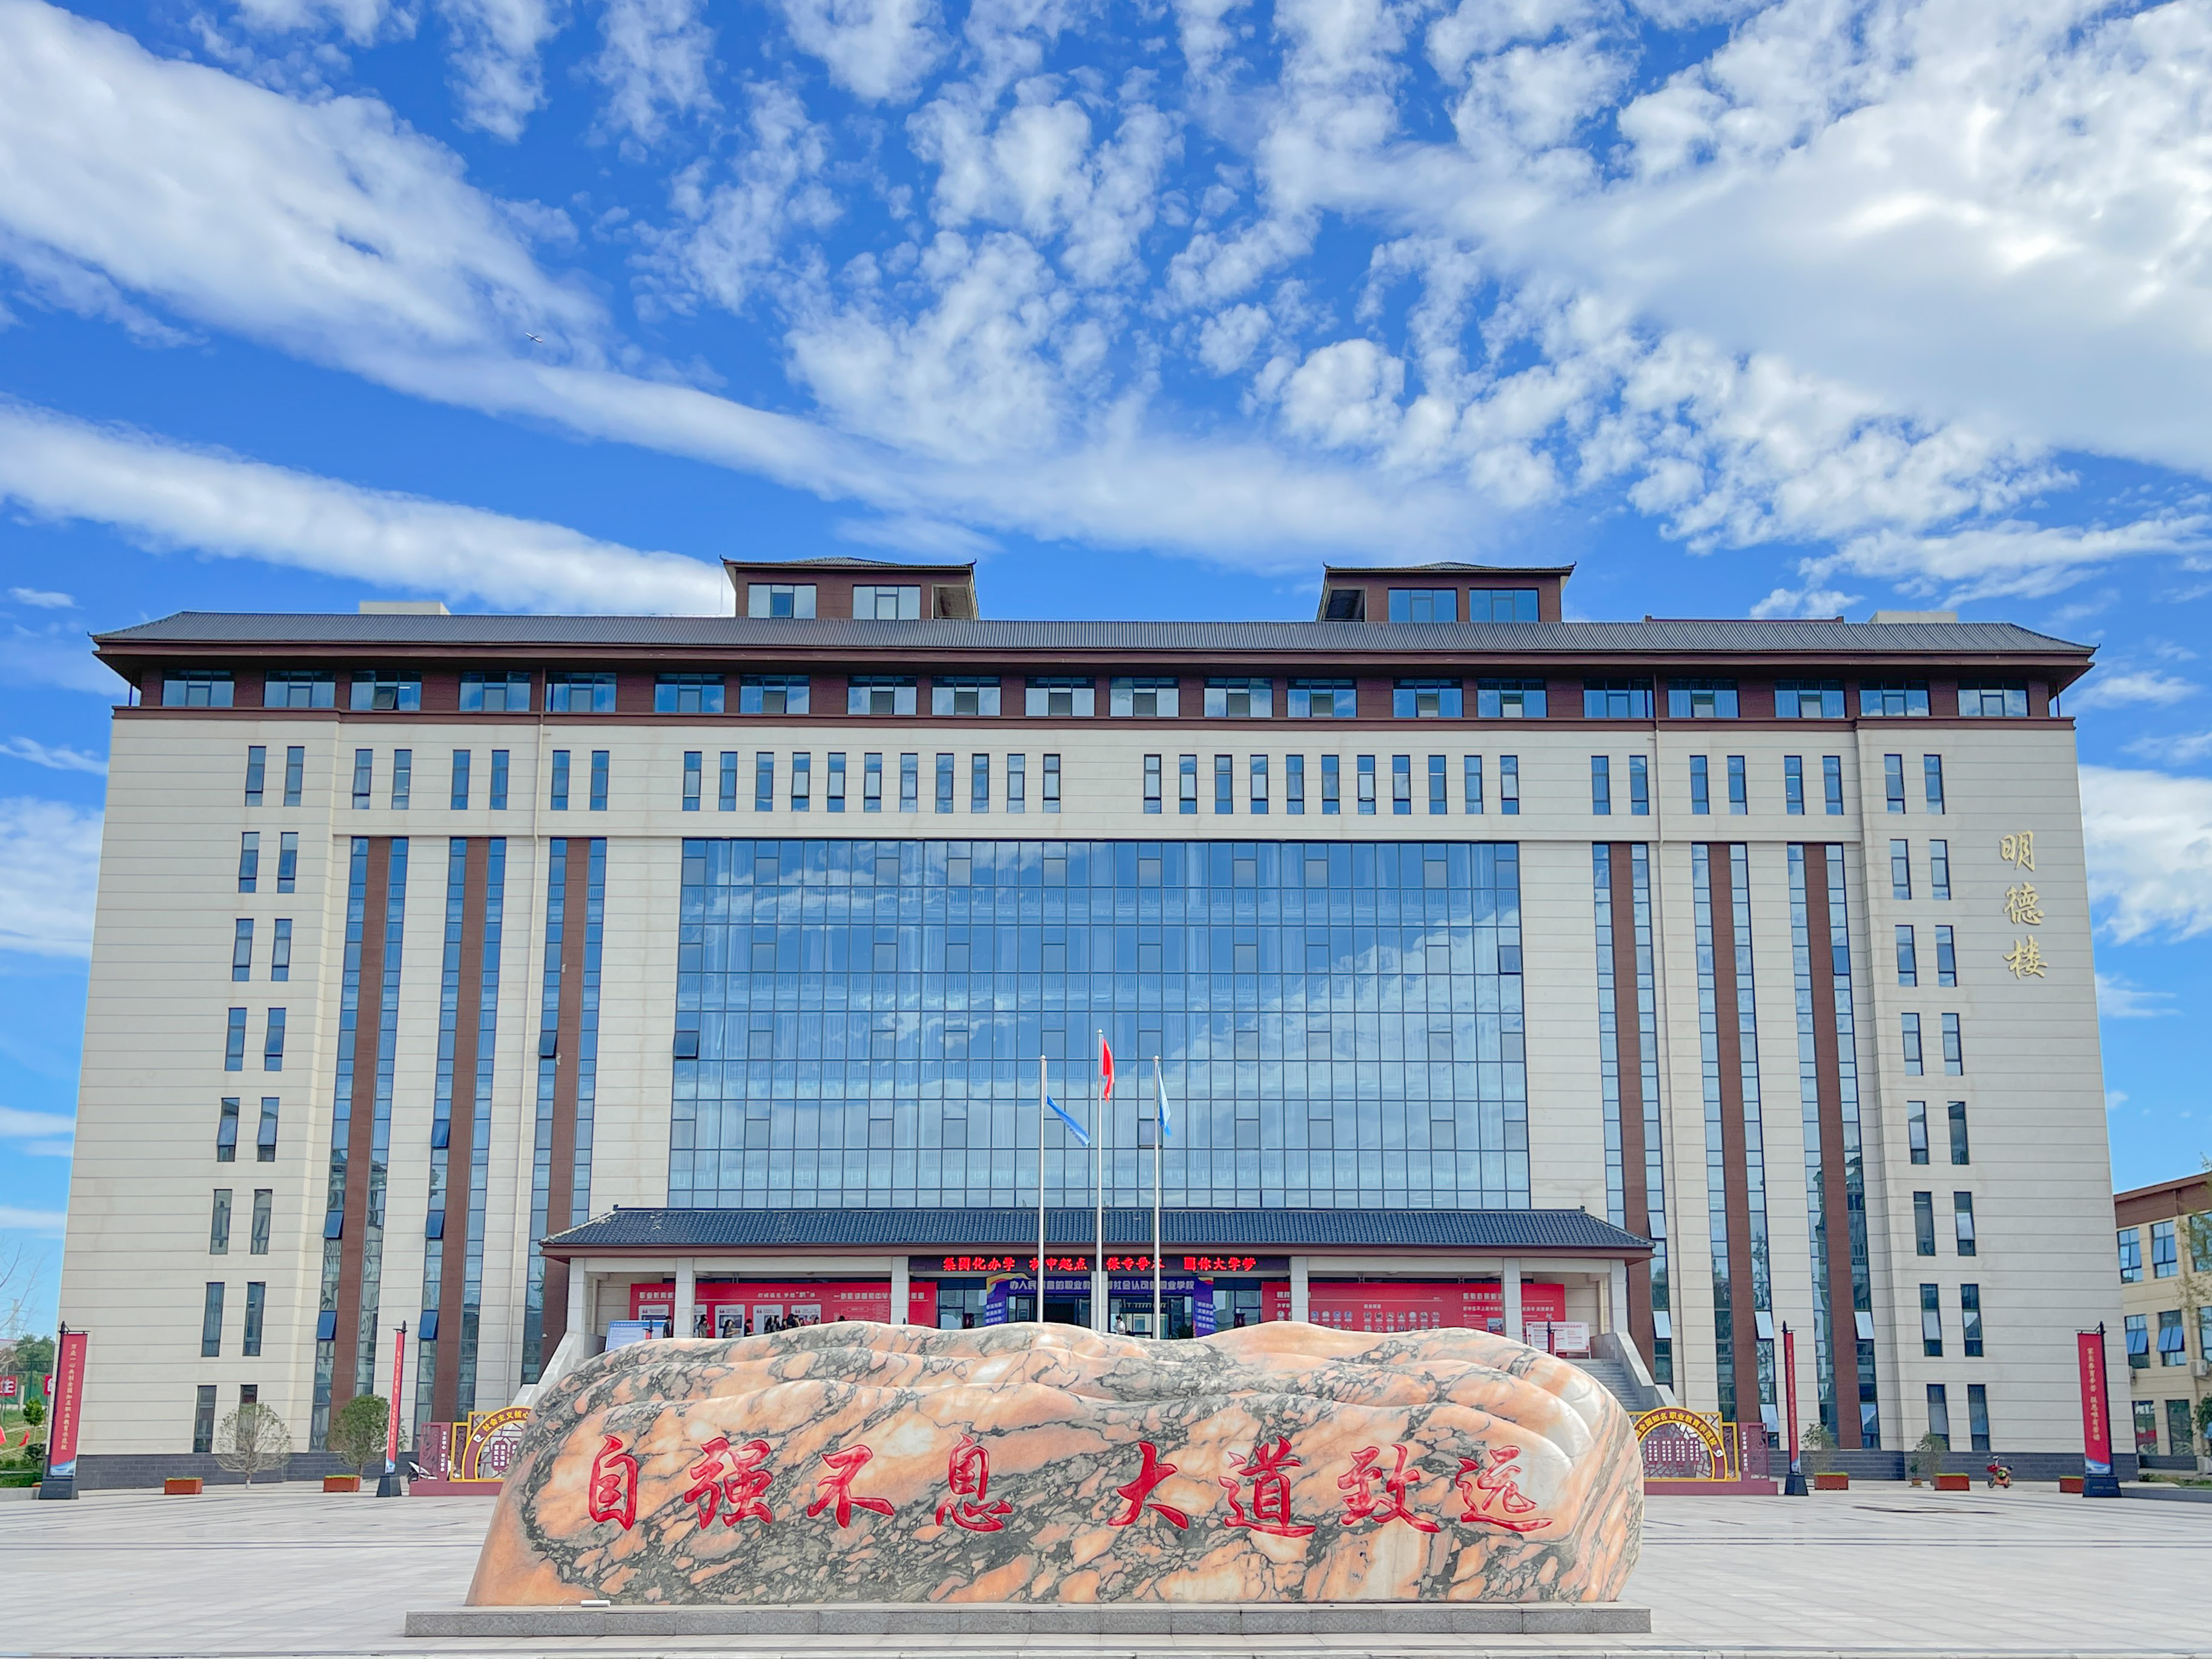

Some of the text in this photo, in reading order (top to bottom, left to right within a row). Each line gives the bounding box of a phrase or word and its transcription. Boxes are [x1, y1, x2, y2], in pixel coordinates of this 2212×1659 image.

[2000, 830, 2048, 979] 明德楼
[942, 1257, 1015, 1271] 集团化办学
[1010, 1280, 1091, 1291] 办人民意的职业教
[588, 1433, 1554, 1538] 自强不息 大道致远
